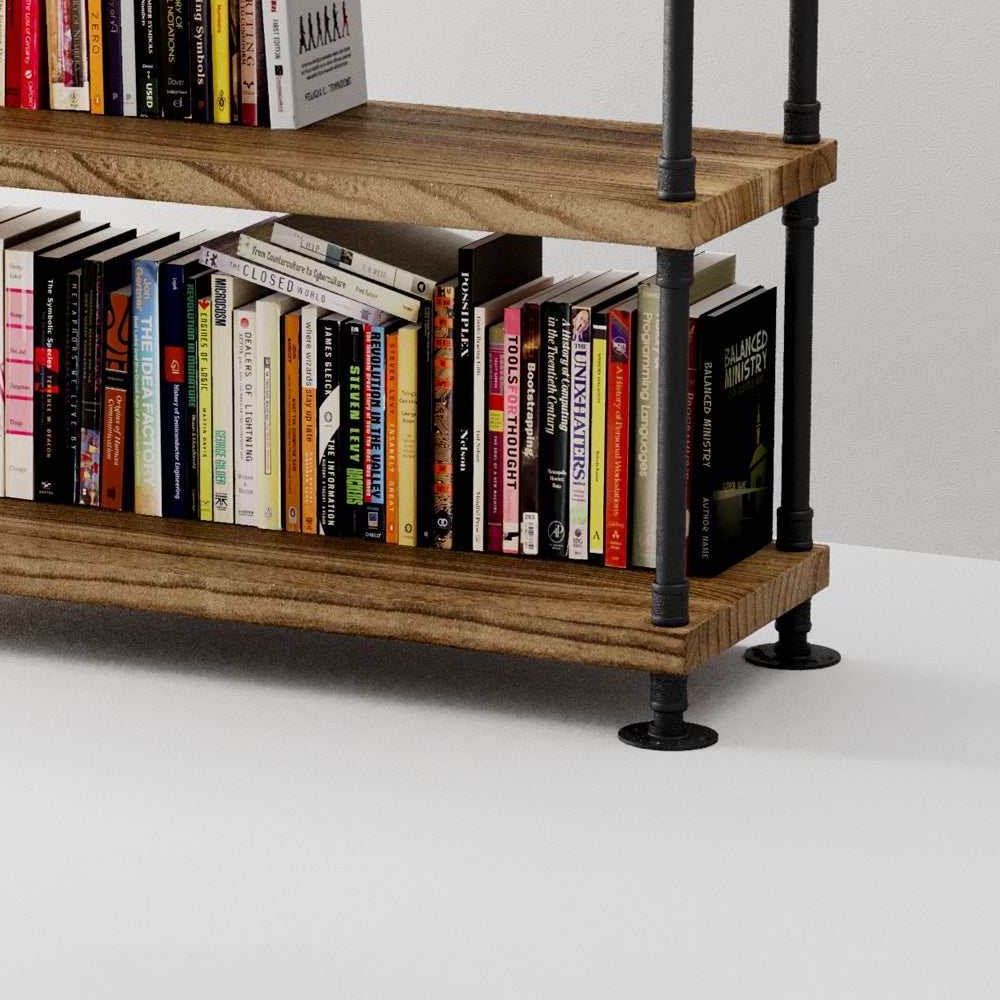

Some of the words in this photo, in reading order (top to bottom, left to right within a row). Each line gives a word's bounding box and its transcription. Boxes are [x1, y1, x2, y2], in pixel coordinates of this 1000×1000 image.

[167, 6, 175, 62] NOTATIONS
[194, 26, 205, 85] Symbols
[215, 278, 226, 326] MICROCOSM
[230, 261, 241, 272] THE
[242, 263, 294, 293] CLOSED
[297, 287, 326, 303] WORLD
[46, 298, 54, 334] Symbolic
[141, 316, 152, 351] THE
[461, 272, 470, 357] POSSIPLEX
[547, 317, 557, 326] in
[561, 319, 570, 327] A
[46, 338, 54, 368] Species
[547, 329, 557, 344] the
[560, 329, 570, 365] History
[724, 329, 768, 368] BALANCED
[142, 356, 153, 395] IDEA
[372, 331, 381, 407] REVOLUTION
[508, 336, 518, 384] TOOLS
[546, 346, 557, 393] Twentieth
[560, 367, 570, 377] of
[724, 349, 767, 390] MINISTRY
[245, 384, 252, 395] OF
[350, 365, 360, 420] STEVEN
[508, 385, 518, 414] FOR
[560, 379, 570, 431] Computing
[372, 411, 381, 424] IN
[524, 363, 536, 458] Bootstrapping
[546, 396, 556, 434] Century
[574, 350, 587, 480] UNIX-HATERS
[142, 402, 154, 486] FACTORY
[245, 404, 253, 462] LIGHTNING
[350, 428, 360, 462] LEVY
[372, 429, 381, 453] THE
[460, 429, 468, 471] Nelson
[507, 415, 517, 490] THOUGHT
[346, 468, 363, 505] HACKERS
[372, 455, 382, 498] VALLEY
